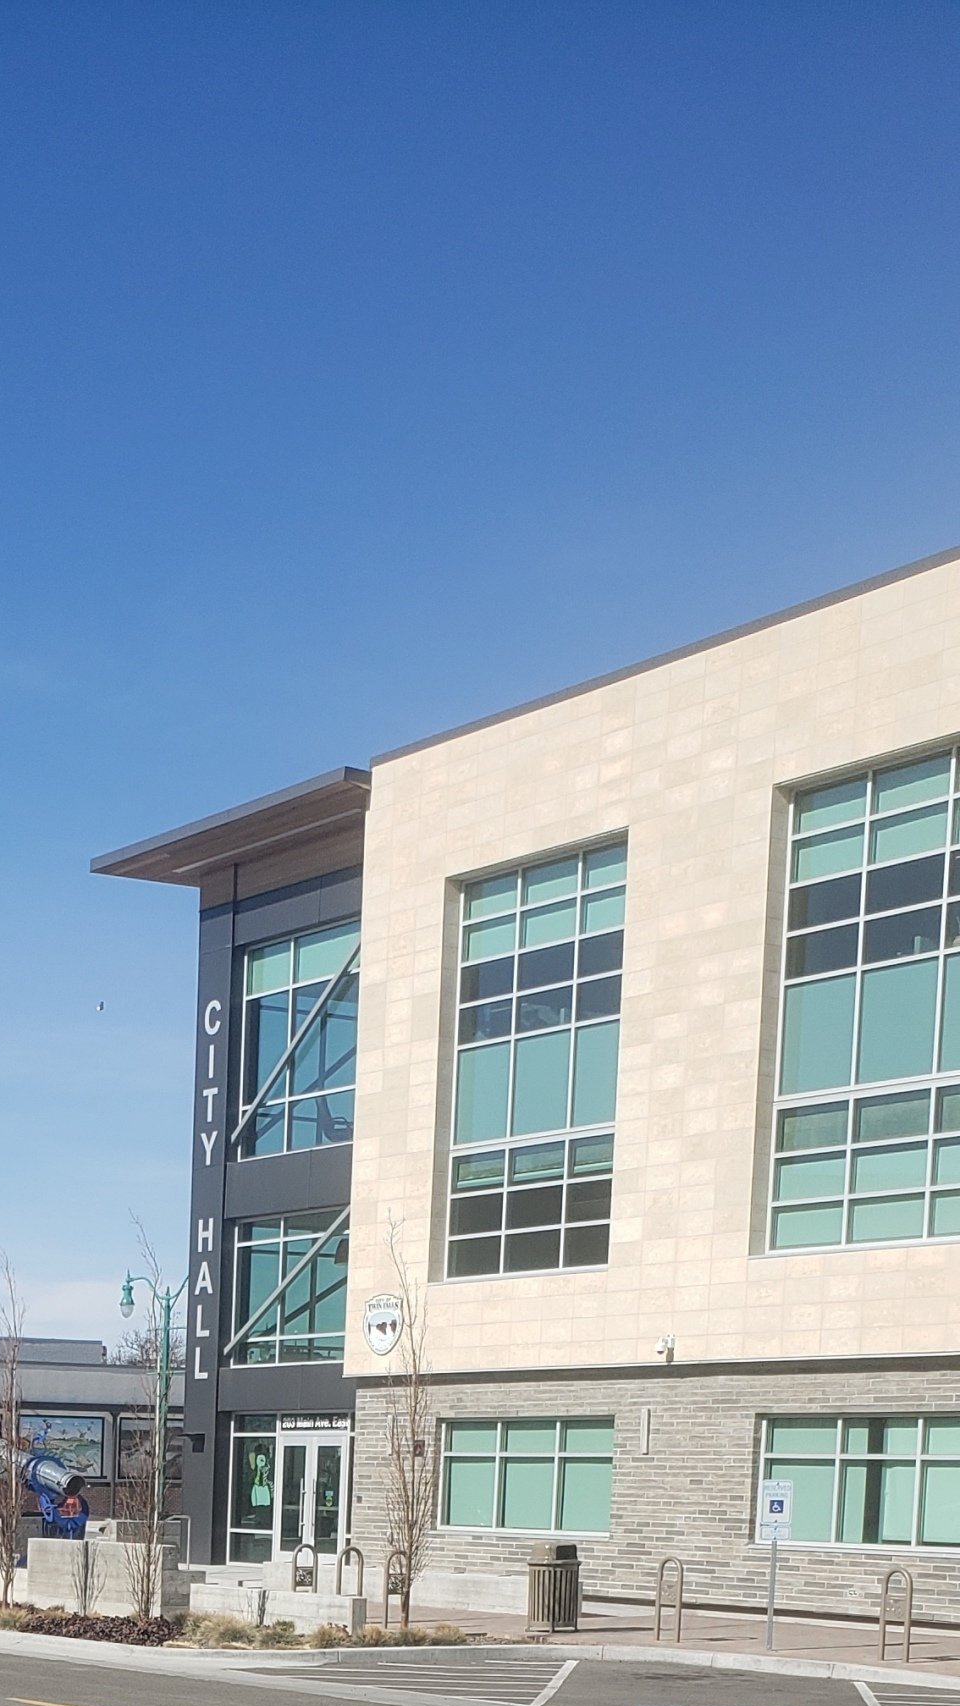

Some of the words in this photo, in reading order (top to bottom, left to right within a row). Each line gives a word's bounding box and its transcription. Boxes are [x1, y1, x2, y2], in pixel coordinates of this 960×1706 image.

[200, 1000, 222, 1166] CITY
[194, 1217, 214, 1379] HALL
[296, 1416, 314, 1428] Main
[315, 1416, 331, 1428] Ave.
